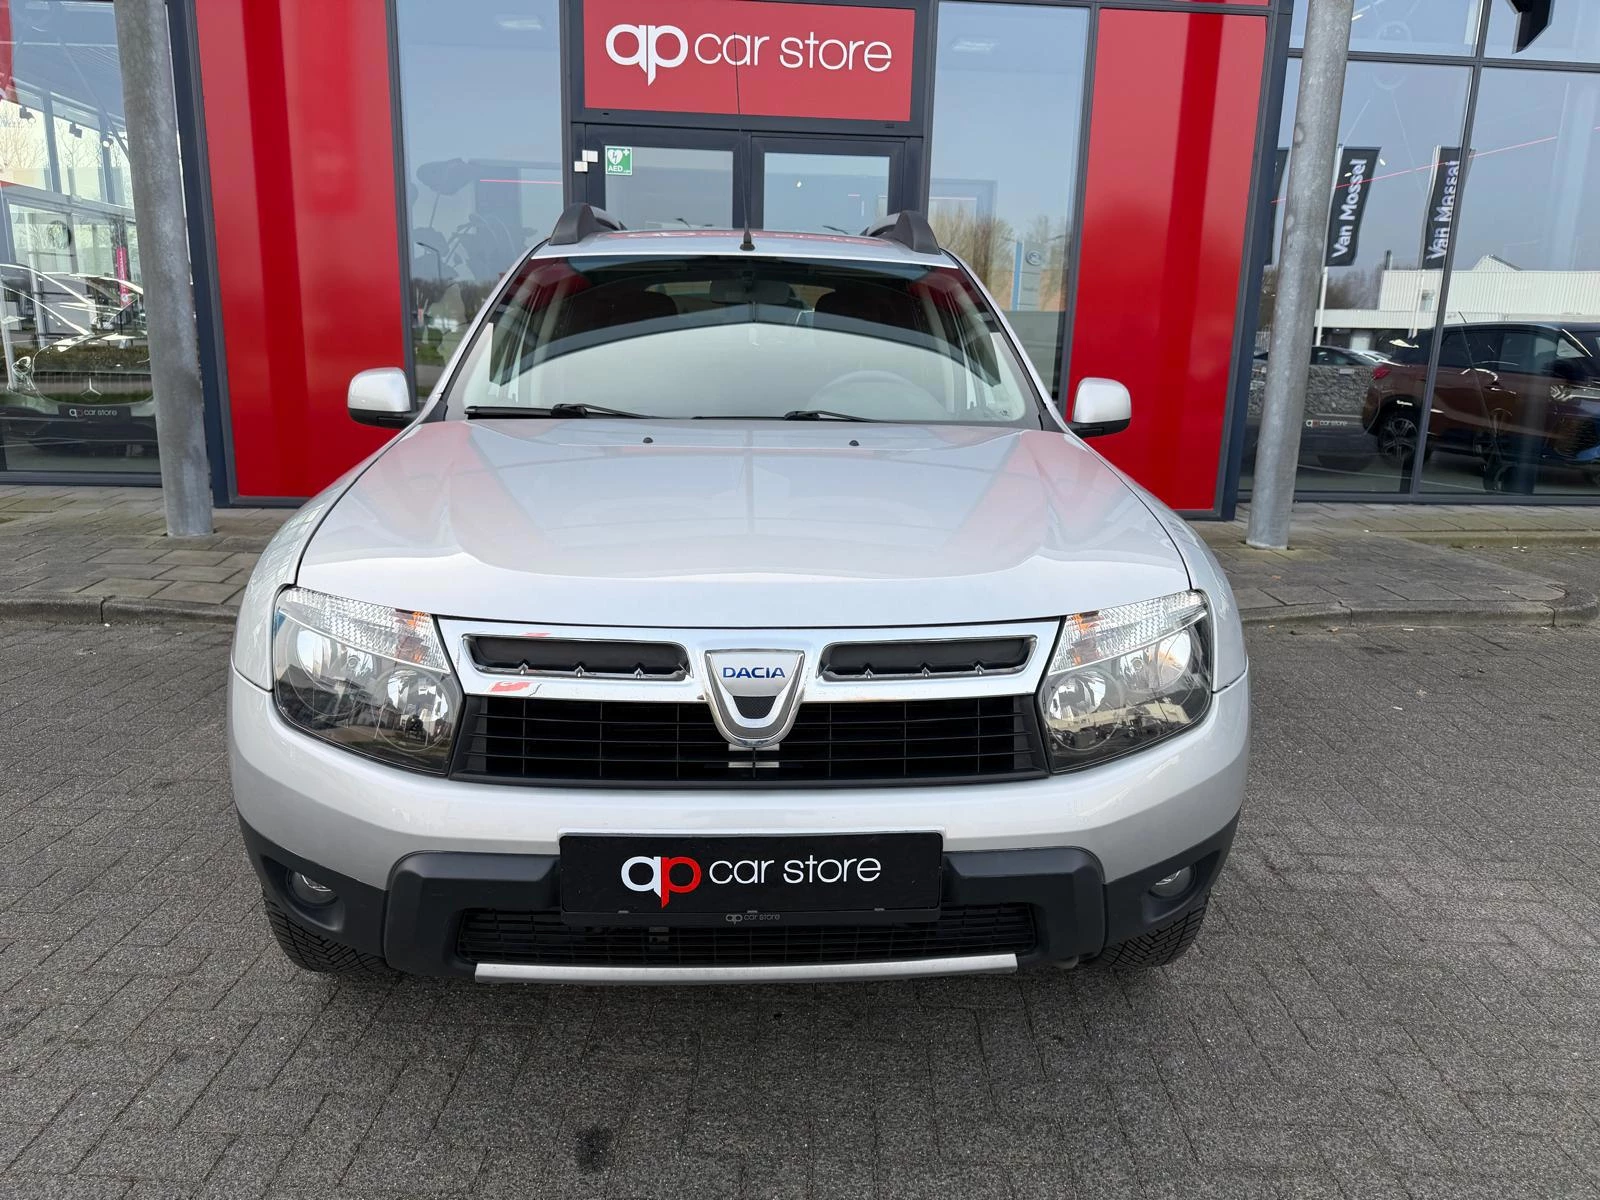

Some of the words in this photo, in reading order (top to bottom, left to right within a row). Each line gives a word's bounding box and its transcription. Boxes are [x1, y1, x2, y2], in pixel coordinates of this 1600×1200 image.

[694, 33, 770, 66] car
[779, 32, 892, 72] store
[1338, 159, 1367, 221] Mossel
[1331, 225, 1353, 258] Van
[1426, 226, 1450, 260] Van
[722, 667, 786, 678] DACIA
[709, 860, 775, 884] car
[783, 855, 882, 883] store
